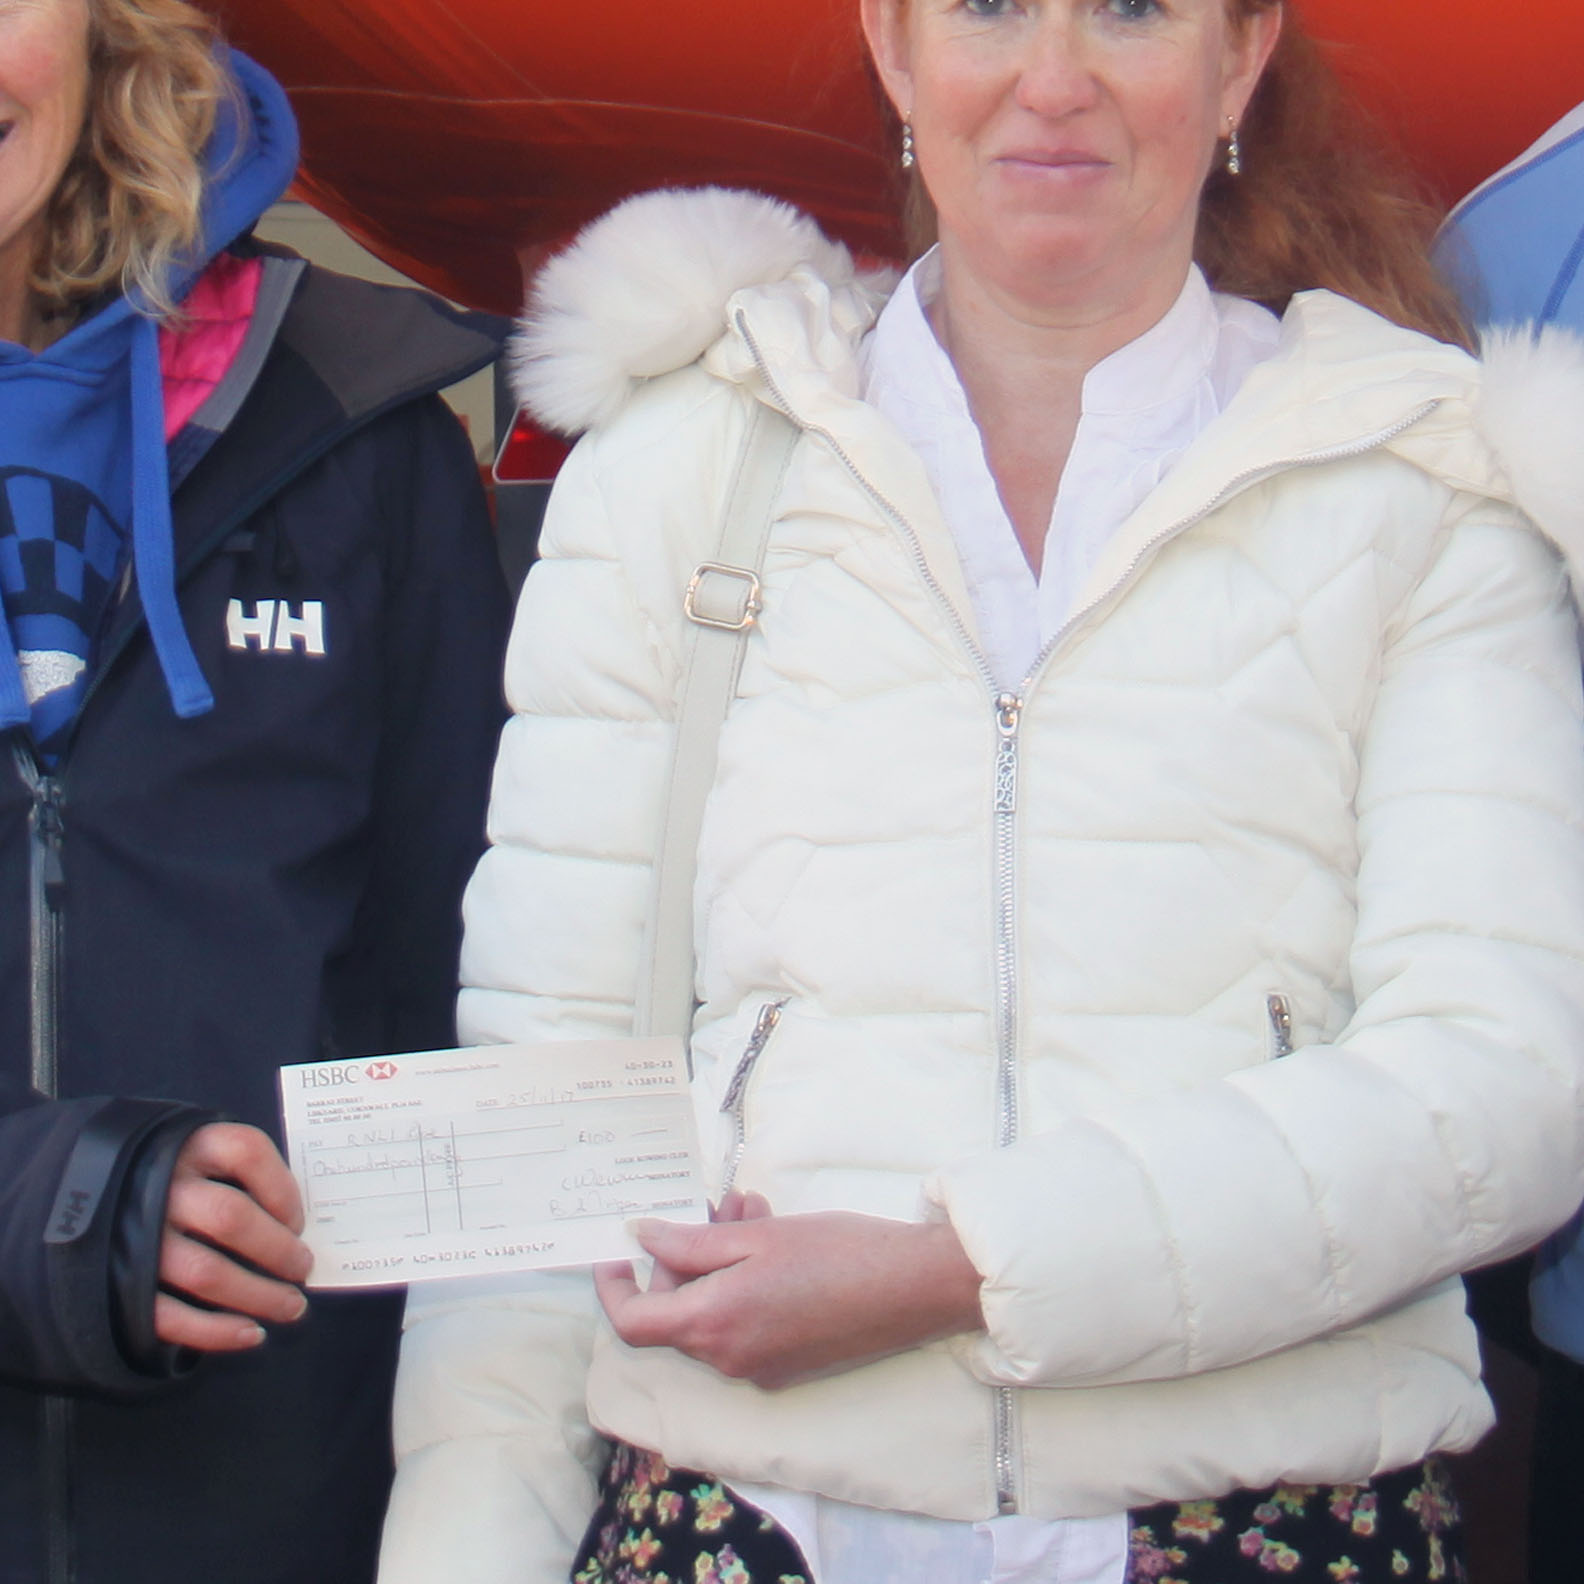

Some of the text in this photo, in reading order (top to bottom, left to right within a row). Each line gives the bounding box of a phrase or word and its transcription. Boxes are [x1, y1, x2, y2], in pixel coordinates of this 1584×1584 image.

[228, 598, 325, 655] HH
[302, 1065, 360, 1089] HSBC
[56, 1191, 91, 1235] HH
